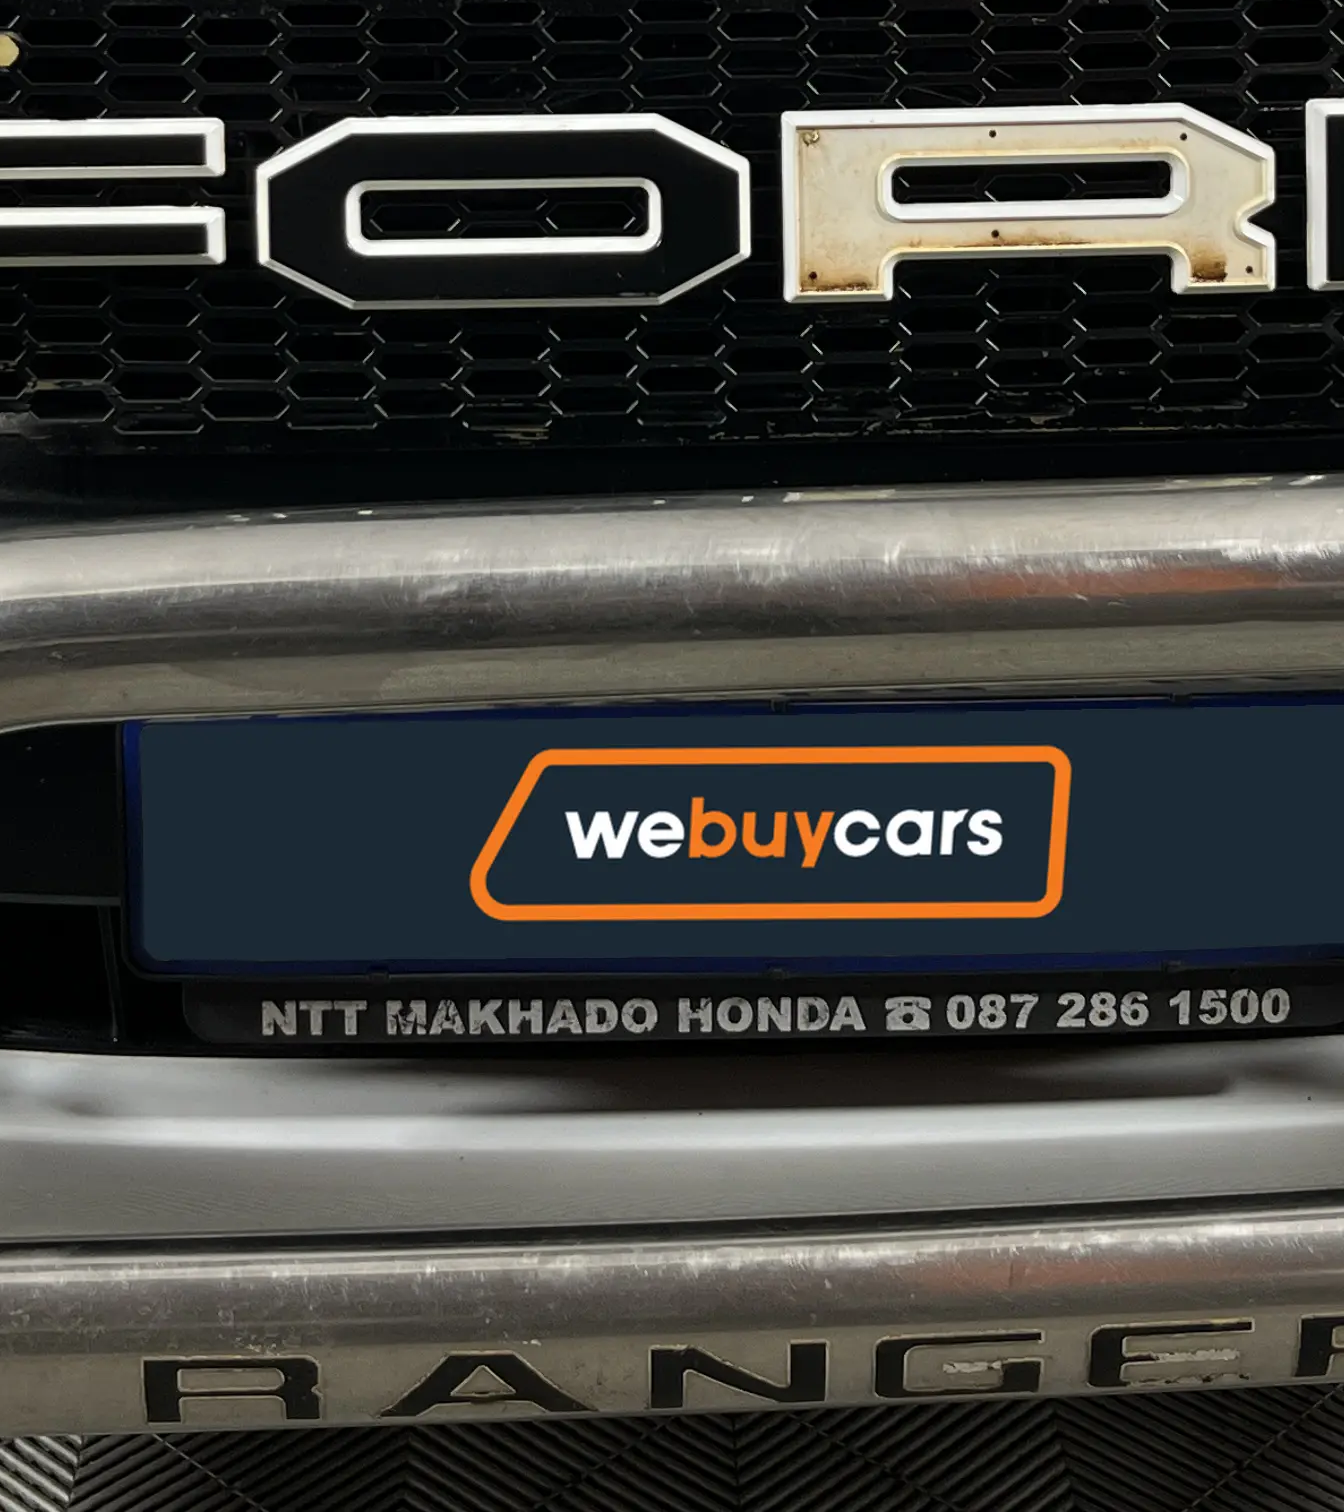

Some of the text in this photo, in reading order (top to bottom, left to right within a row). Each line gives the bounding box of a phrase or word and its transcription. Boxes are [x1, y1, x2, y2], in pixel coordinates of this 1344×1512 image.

[260, 987, 1291, 1036] NTT MAKHADO HONDA 087 286 1500
